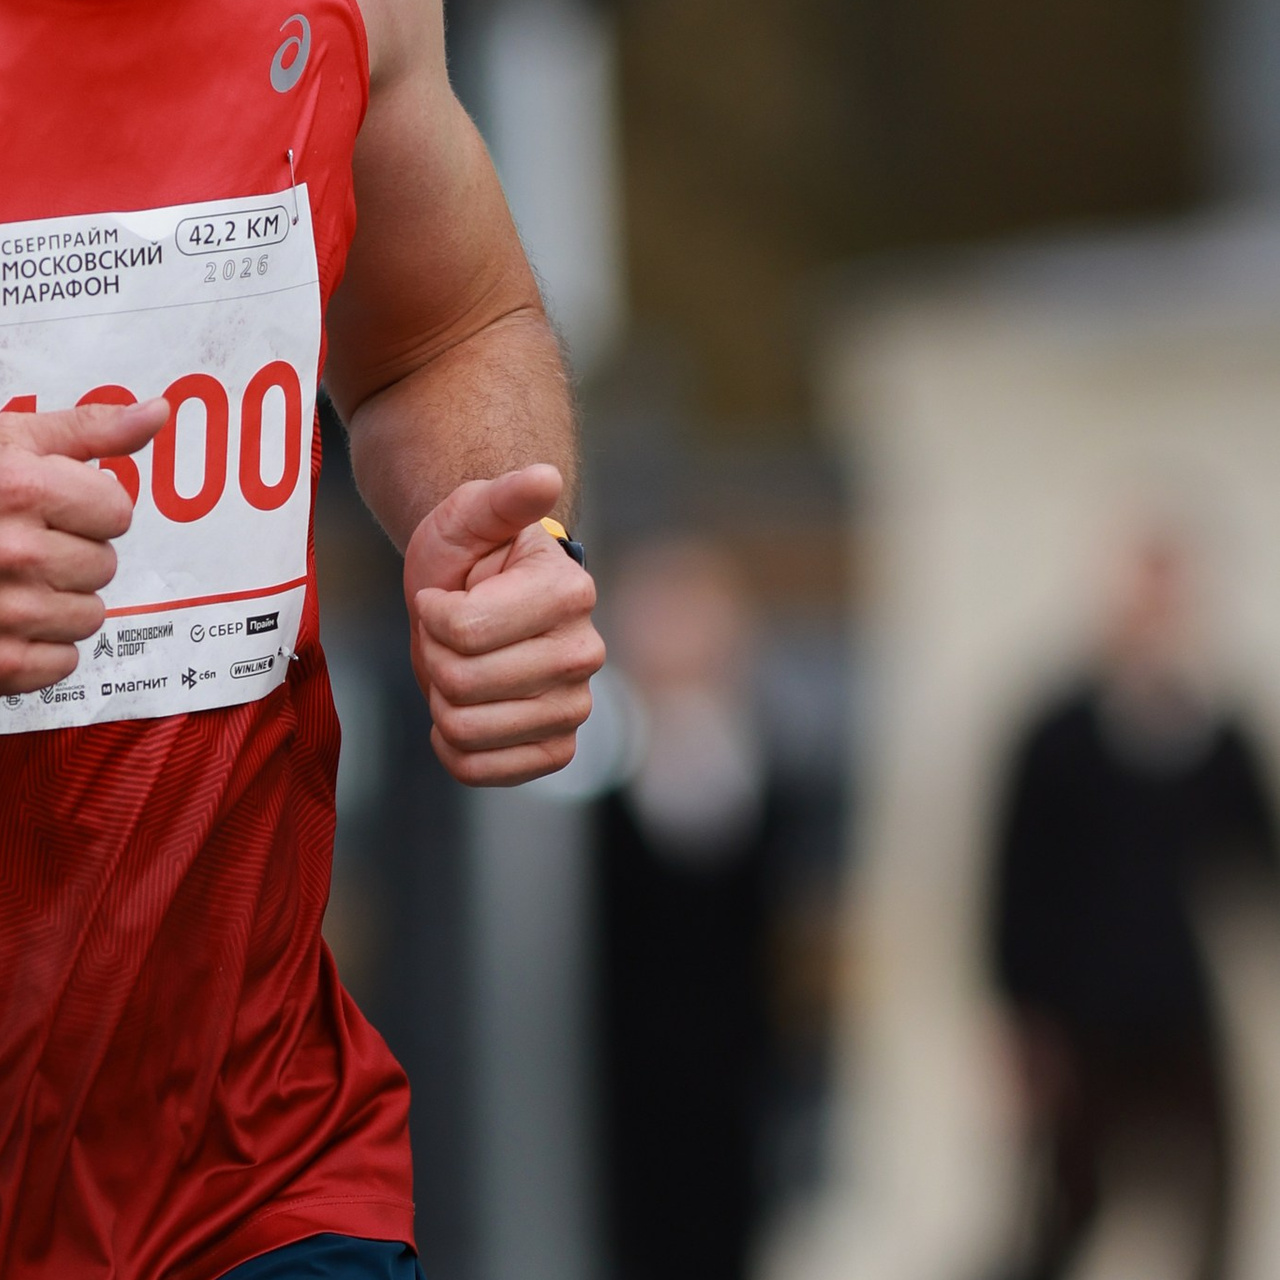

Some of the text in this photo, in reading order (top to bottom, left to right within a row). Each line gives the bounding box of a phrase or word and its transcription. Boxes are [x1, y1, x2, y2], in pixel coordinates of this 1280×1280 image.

[1, 227, 119, 256] СБЕРПРАЙМ
[189, 220, 237, 247] 42,2
[2, 241, 163, 281] МОСКОВСКИЙ
[204, 254, 269, 283] 2026
[2, 275, 120, 306] МАРАФОН
[117, 621, 174, 644] МОСКОВСКИЙ
[208, 622, 243, 637] СБЕР
[117, 642, 146, 658] СПОРТ
[234, 659, 268, 676] WINLINE
[55, 690, 86, 704] BRICS
